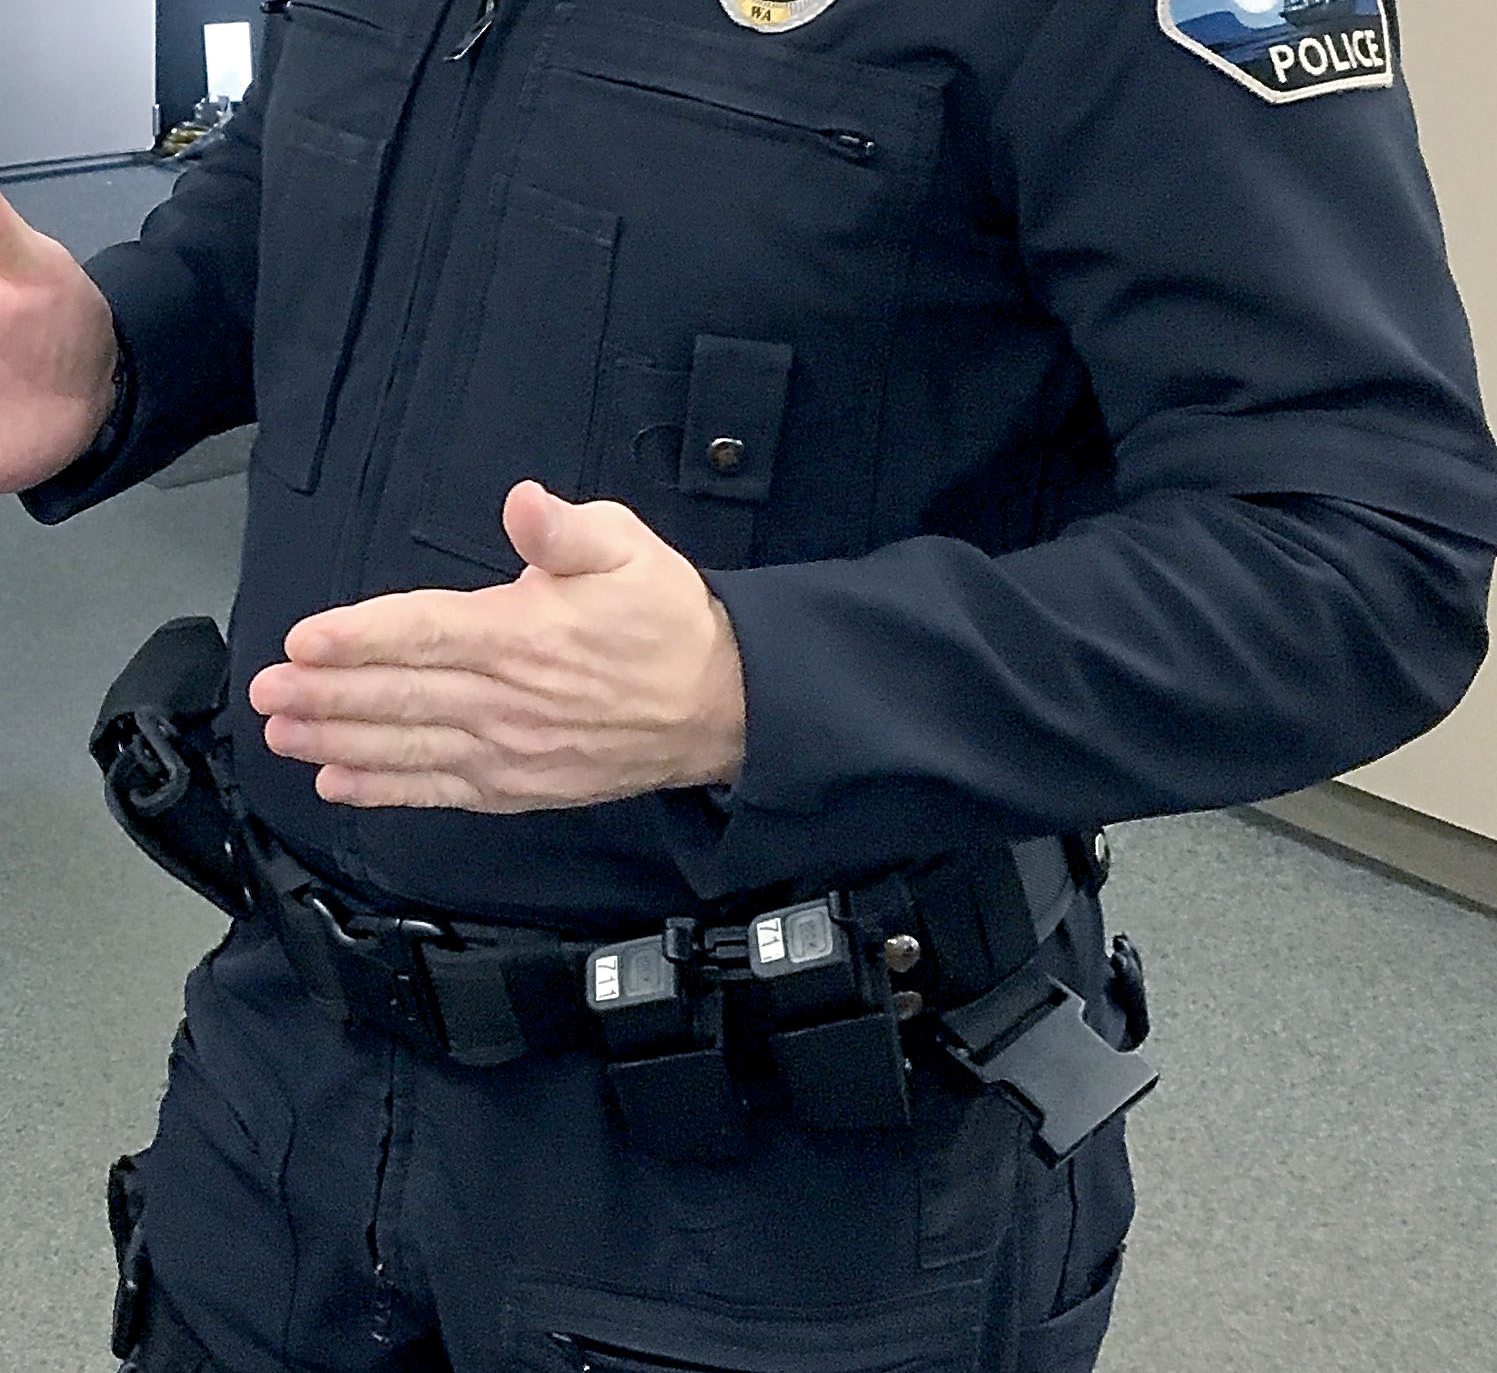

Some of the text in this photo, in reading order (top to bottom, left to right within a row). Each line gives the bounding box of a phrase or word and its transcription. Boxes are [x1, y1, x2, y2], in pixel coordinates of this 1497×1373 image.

[751, 5, 771, 22] WA
[1268, 28, 1385, 84] POLICE
[597, 958, 618, 1000] 711
